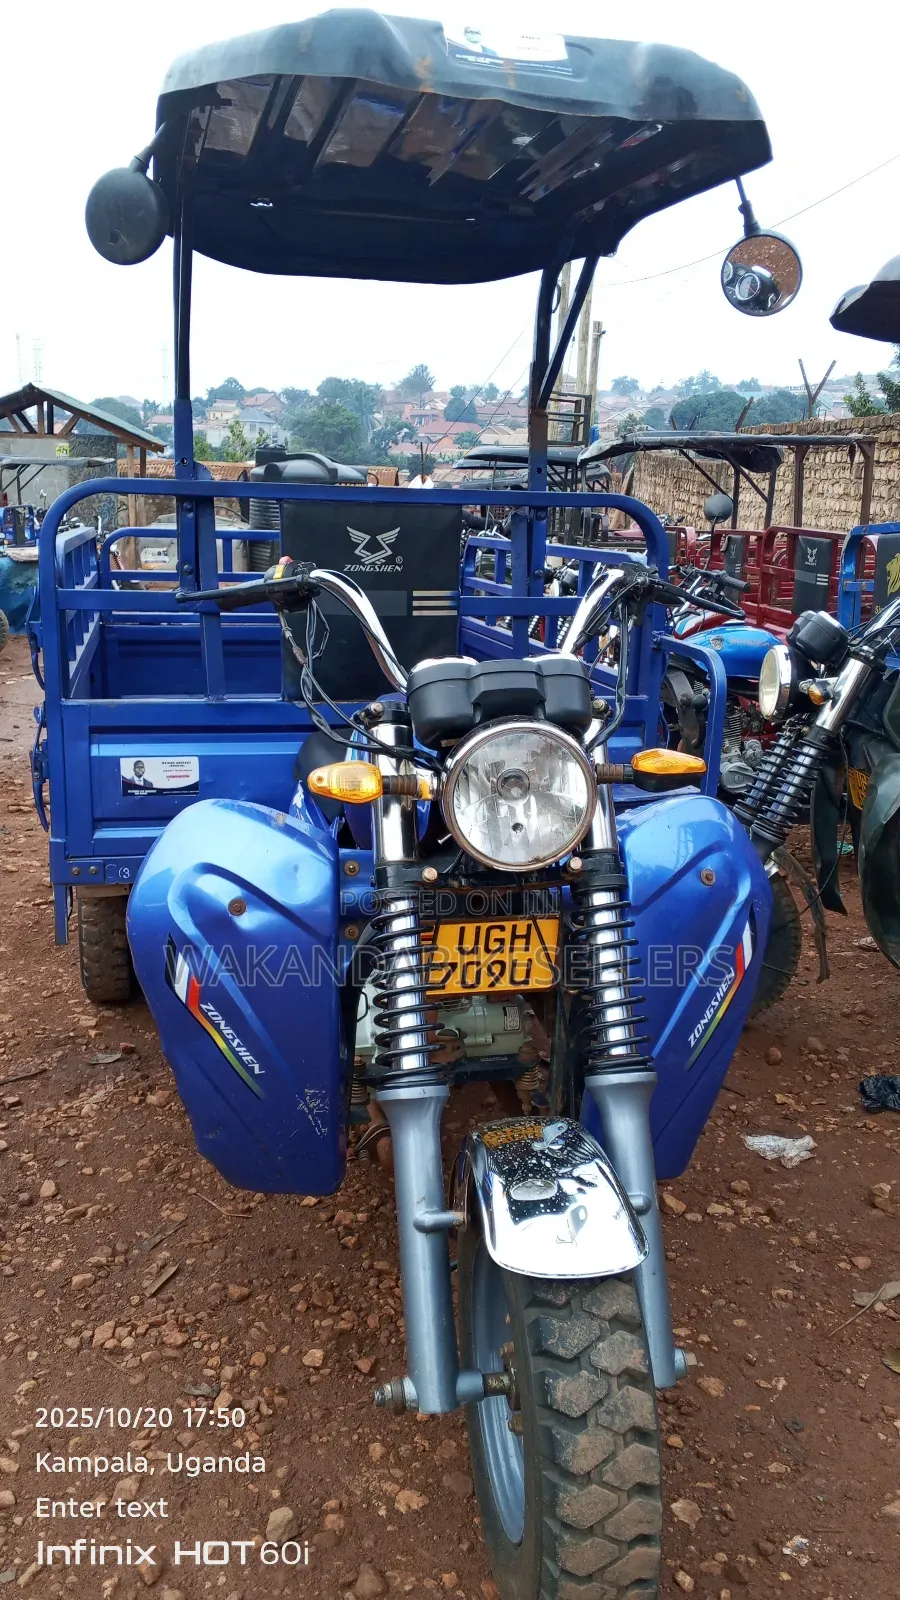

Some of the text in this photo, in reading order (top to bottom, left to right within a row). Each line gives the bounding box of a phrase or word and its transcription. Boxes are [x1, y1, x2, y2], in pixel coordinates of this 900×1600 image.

[343, 564, 403, 572] ZONGSHEN
[457, 923, 533, 956] UGH
[688, 967, 736, 1049] ZONGSHEN
[199, 1002, 266, 1076] ZONGSHEN
